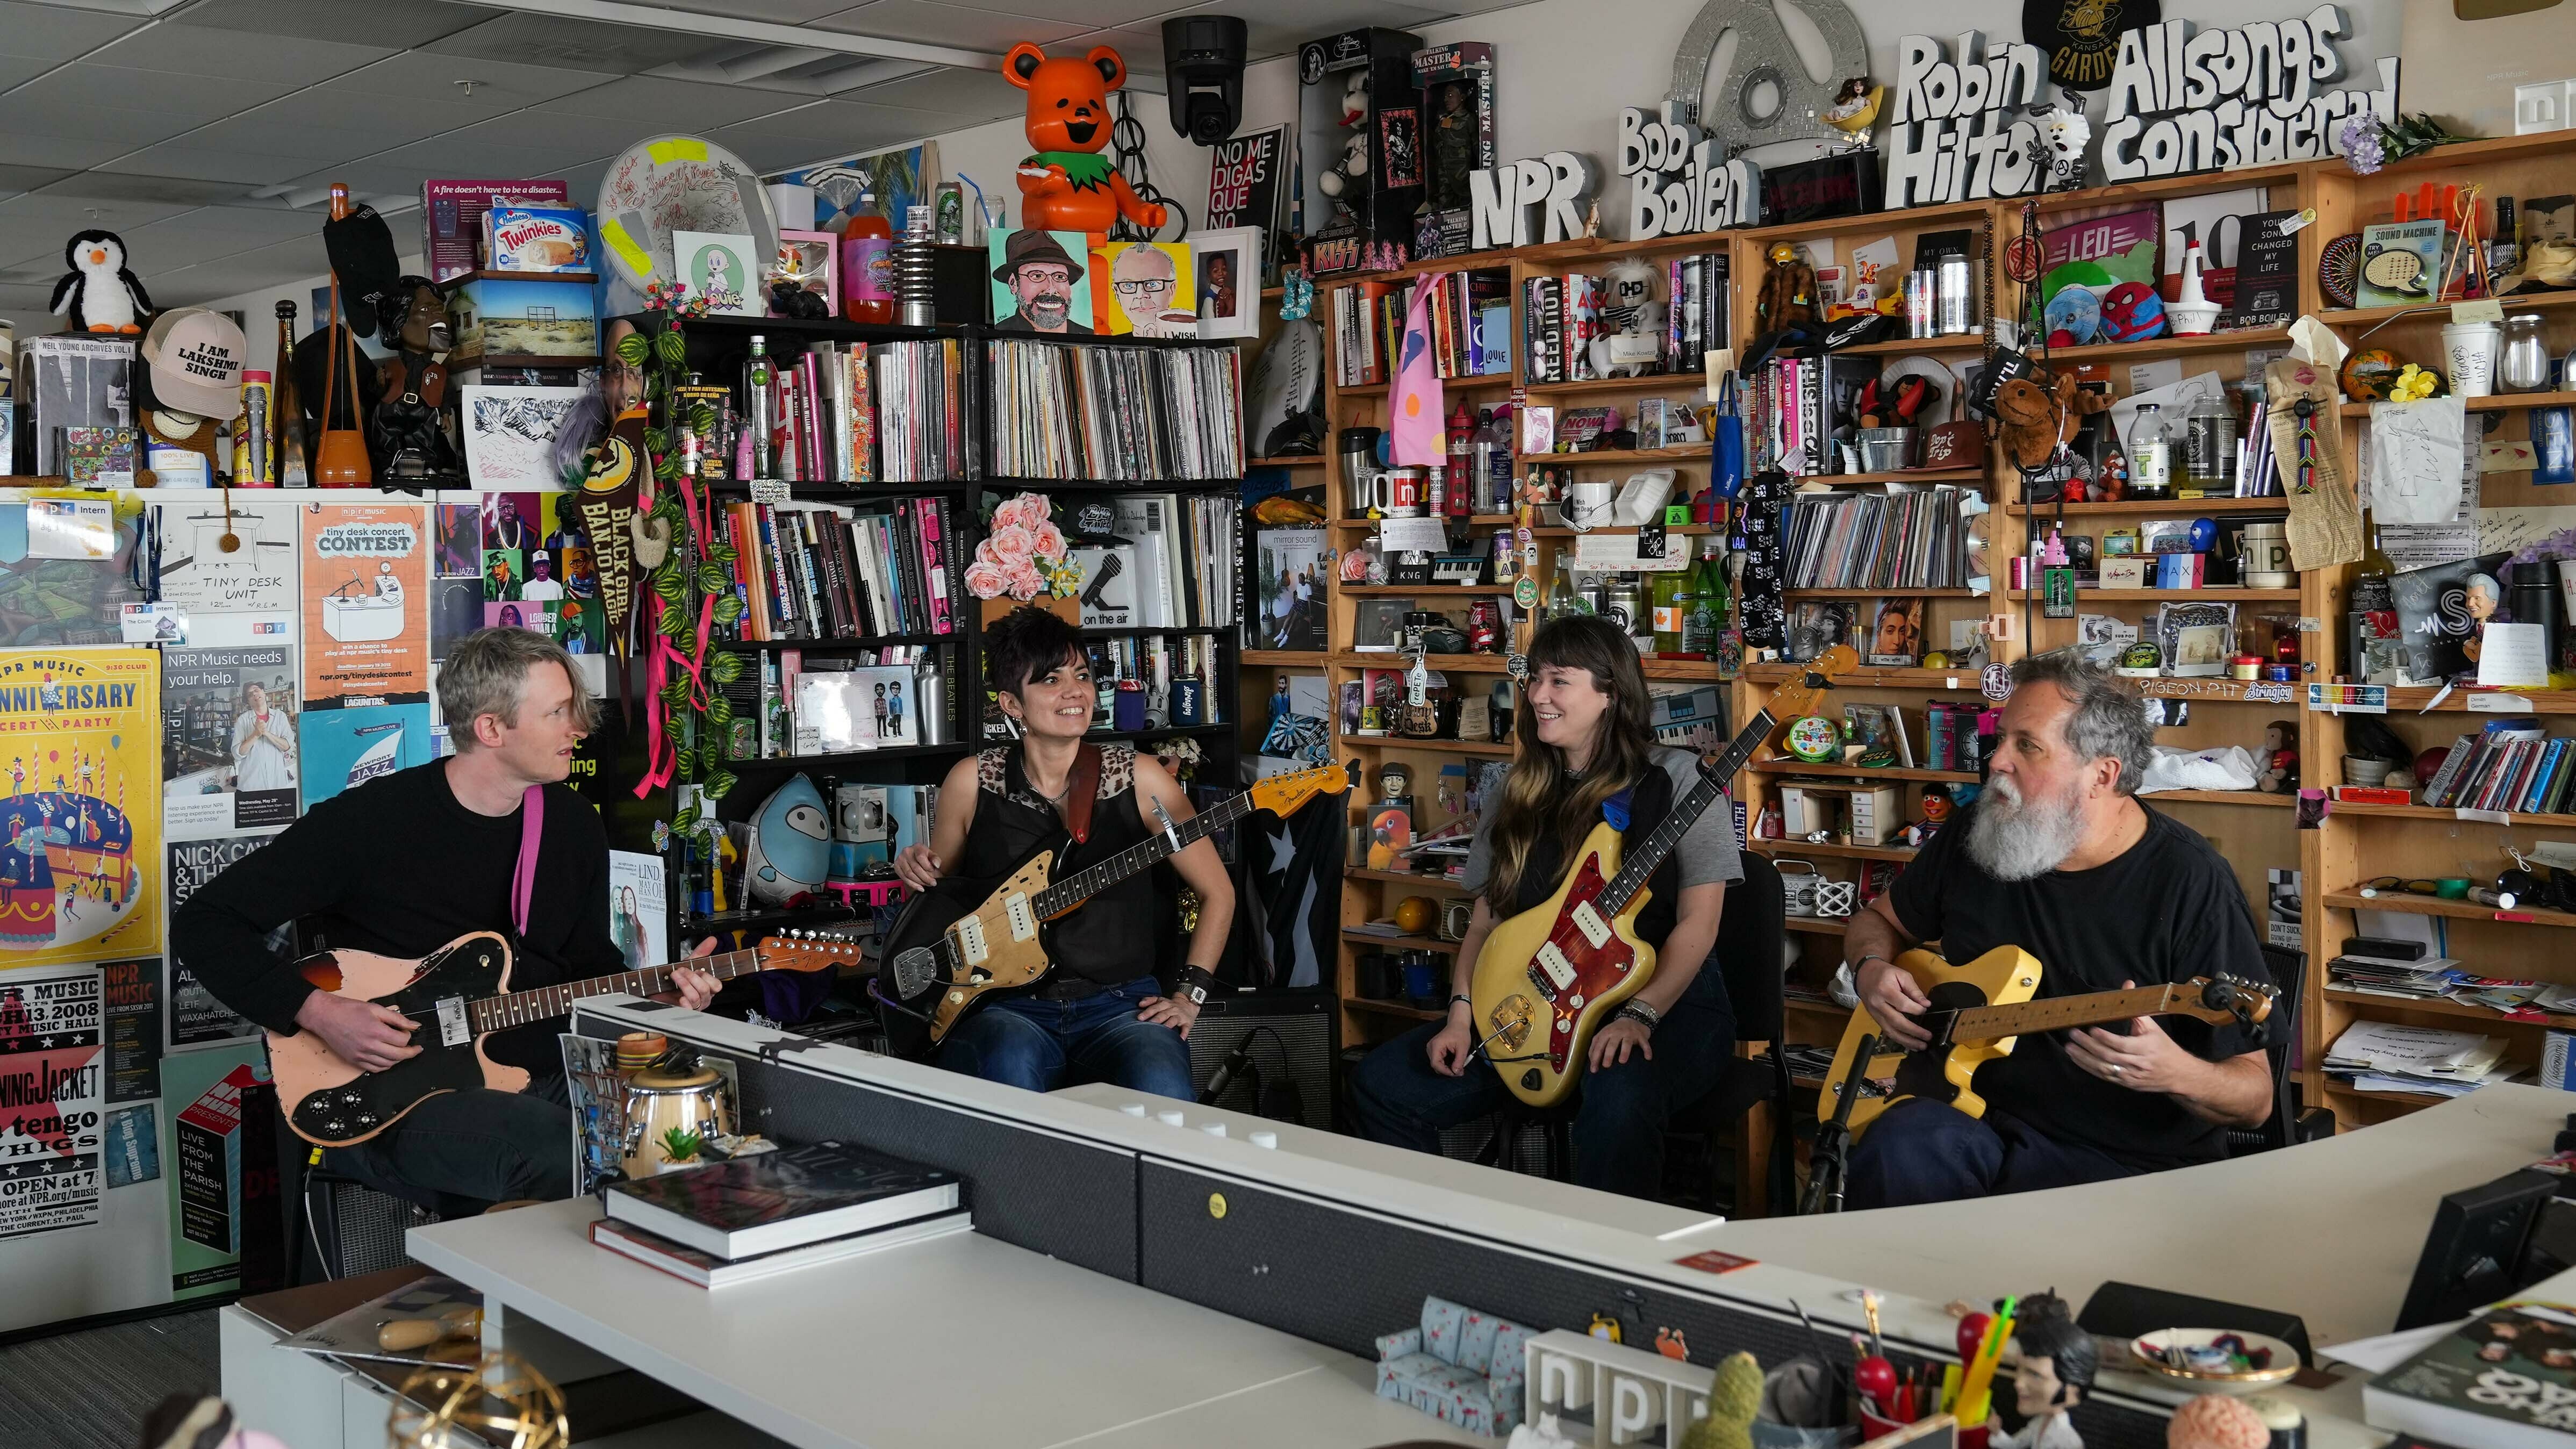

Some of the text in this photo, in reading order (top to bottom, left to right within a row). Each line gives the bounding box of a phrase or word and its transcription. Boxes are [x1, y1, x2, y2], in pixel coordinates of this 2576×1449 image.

[1426, 46, 1448, 54] TALKING
[2072, 38, 2112, 52] KANSAS
[1414, 53, 1451, 68] MASTER
[2104, 4, 2350, 126] Allsongs
[1892, 30, 2048, 125] Robin
[1618, 100, 1698, 178] Bob
[1216, 134, 1271, 163] NO ME
[1212, 161, 1265, 190] DIGAS
[484, 186, 500, 194] have
[511, 186, 519, 194] be
[527, 186, 562, 195] disaster...
[1631, 140, 1760, 241] Boilen
[1211, 188, 1247, 212] QUE
[1470, 151, 1585, 249] NPR
[502, 213, 529, 224] Hostess
[1210, 213, 1236, 230] NO
[499, 224, 562, 250] Twinkies
[2376, 227, 2437, 241] SOUND MACHINE
[2252, 240, 2292, 250] CHANGED
[1314, 238, 1360, 273] KISS
[2260, 263, 2279, 272] LIFE
[1545, 286, 1559, 324] LOU
[2240, 313, 2291, 324] BOB BOILEN
[59, 343, 80, 351] YOUNG
[82, 343, 112, 353] ARCHIVES
[199, 343, 229, 357] I AM
[178, 349, 238, 370] LAKSHMI
[1486, 351, 1506, 363] LOUIE
[1546, 332, 1561, 382] REED
[185, 364, 227, 380] SINGH
[2384, 409, 2408, 417] TREE
[1931, 432, 1954, 448] Don't
[1929, 445, 1951, 460] Trip
[327, 528, 342, 537] tiny
[343, 528, 362, 536] desk
[1274, 534, 1317, 543] mirror sound
[319, 536, 411, 551] CONTEST
[581, 503, 619, 625] BANJO MAGIC
[611, 506, 630, 617] BLACK GIRL
[947, 543, 956, 579] BERNSTEIN
[203, 577, 282, 587] TINY DESK
[951, 580, 956, 589] AT
[226, 590, 258, 599] UNIT
[529, 613, 557, 623] LOUDER
[1084, 613, 1128, 625] on the air
[2046, 605, 2072, 616] PRODUCTION
[168, 652, 282, 666] NPR Music needs
[0, 661, 85, 678] PR MUSIC
[320, 670, 412, 681] npr.org/tinydeskcontest
[169, 671, 235, 688] your help.
[2139, 680, 2239, 696] PIGEON PIT
[946, 676, 955, 722] BEATLES
[1183, 685, 1193, 715] Stringjoy
[2245, 682, 2293, 702] Stringjoy
[2313, 685, 2363, 704] SOYUZ
[344, 697, 385, 706] LAGUNITAS
[63, 718, 112, 728] PARTY
[1404, 718, 1431, 733] Desk
[354, 754, 391, 770] NEWPORT
[353, 761, 390, 781] JAZZ
[175, 845, 226, 867] NICK
[106, 964, 138, 985] NPR
[34, 980, 98, 1000] MUSIC
[107, 982, 153, 1005] MUSIC
[178, 987, 206, 997] YOUTH
[27, 1003, 98, 1021] 13, 2008
[117, 1005, 130, 1013] FROM
[19, 1018, 99, 1035] MUSIC HALL
[12, 1111, 98, 1137] tengo
[189, 1106, 236, 1128] PRESENTS
[121, 1118, 133, 1139] Blog
[182, 1131, 205, 1146] LIVE
[126, 1139, 142, 1180] Supreme
[183, 1144, 213, 1162] FROM
[183, 1157, 204, 1172] THE
[3, 1171, 95, 1196] OPEN at 7
[184, 1170, 221, 1190] PARISH
[18, 1185, 98, 1206] at NPR.org/music
[11, 1205, 98, 1223] YORK WXPN, PHILADELPHIA
[17, 1220, 52, 1229] CURRENT,
